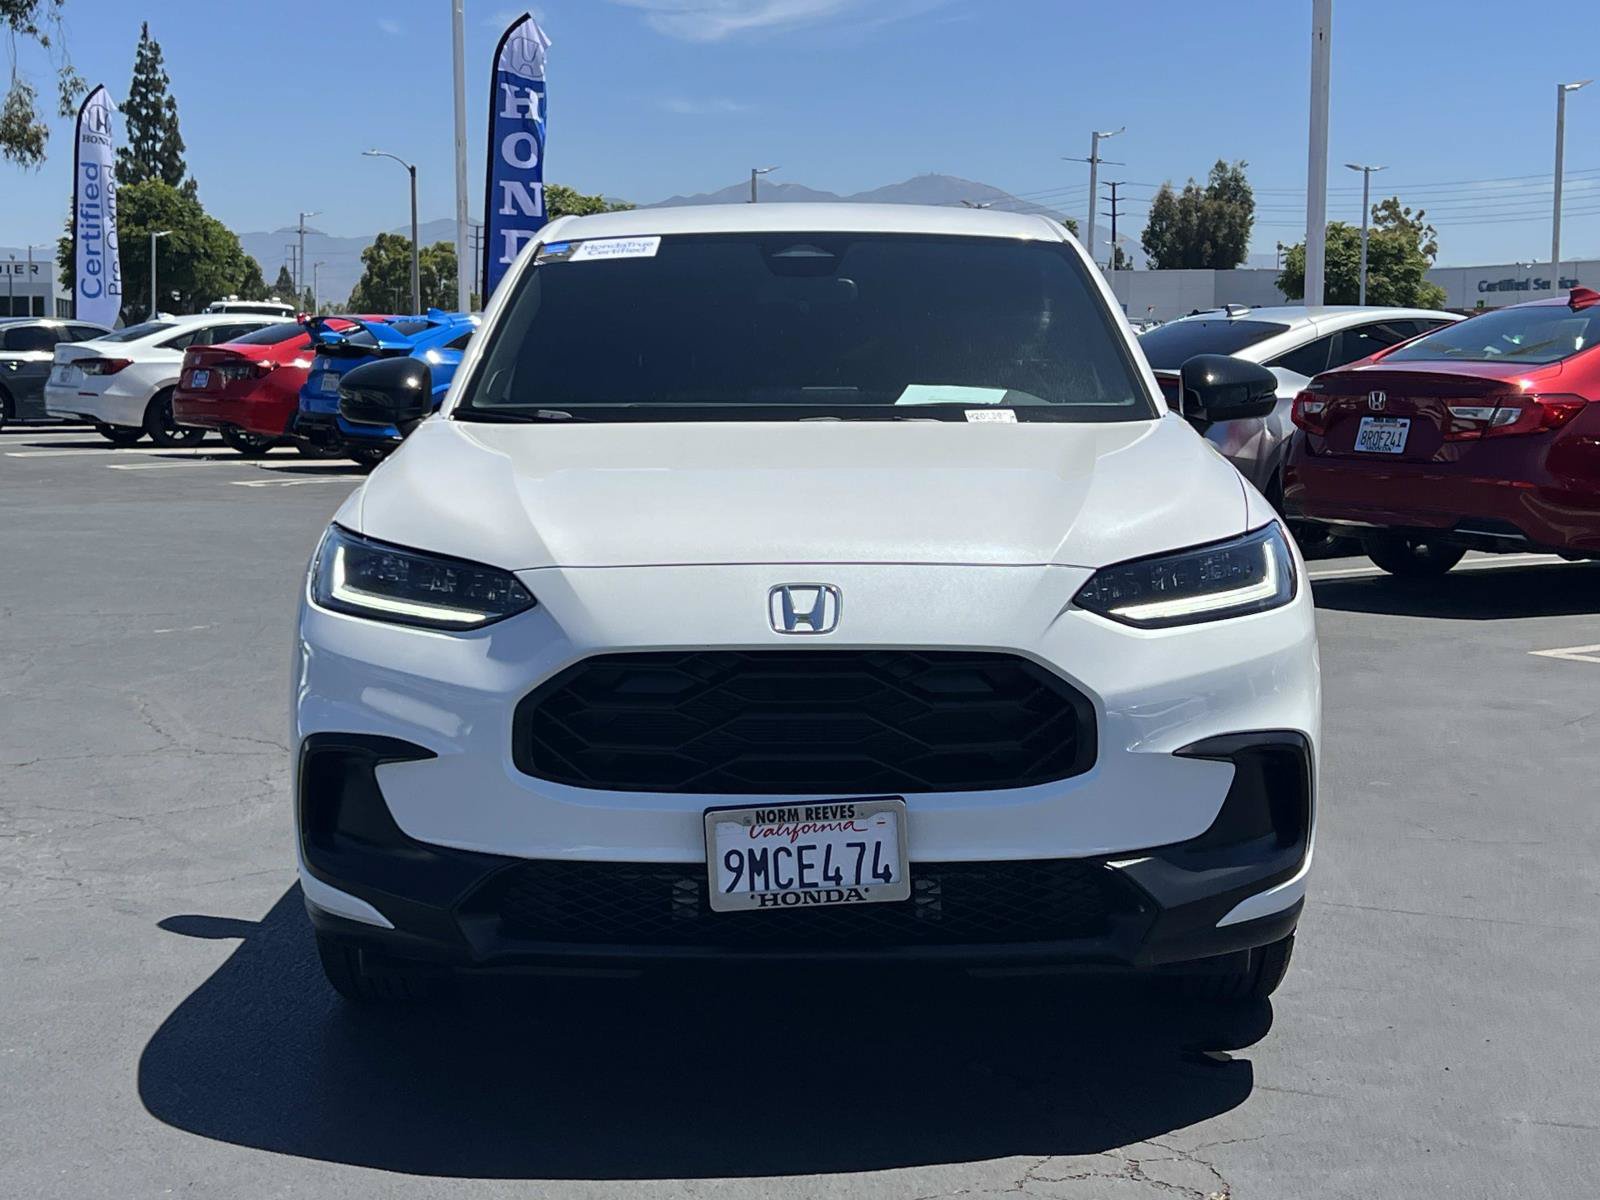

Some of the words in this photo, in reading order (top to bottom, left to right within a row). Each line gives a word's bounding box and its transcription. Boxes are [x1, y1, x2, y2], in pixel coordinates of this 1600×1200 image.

[80, 162, 103, 299] Certified
[1478, 279, 1530, 292] Certified
[755, 808, 799, 824] NORM
[805, 804, 855, 821] REEVES
[749, 820, 868, 844] California
[724, 840, 893, 893] 9MCE474
[757, 887, 867, 907] HONDA
